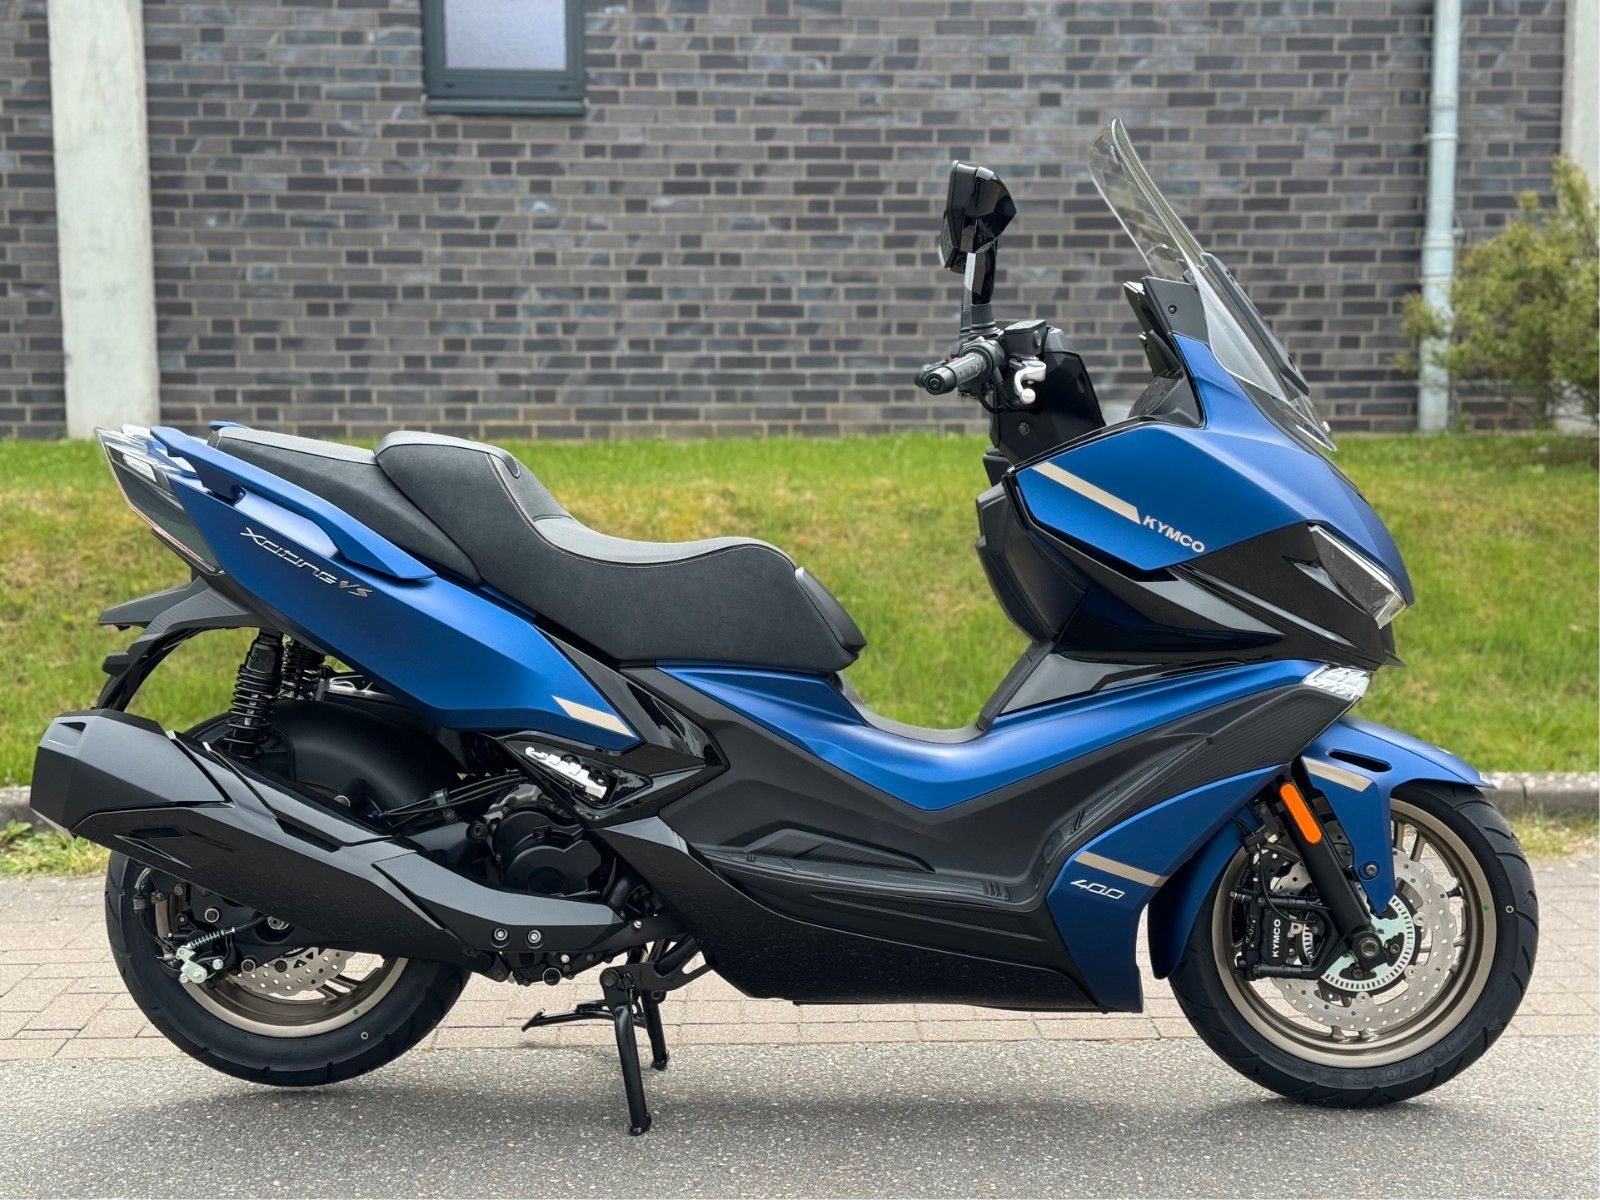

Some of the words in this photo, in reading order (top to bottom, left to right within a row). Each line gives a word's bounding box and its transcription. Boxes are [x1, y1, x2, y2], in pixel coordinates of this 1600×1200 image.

[1142, 515, 1205, 553] KYMCO
[339, 580, 373, 598] VS
[1070, 879, 1125, 899] 400
[1272, 918, 1281, 958] KYMCO
